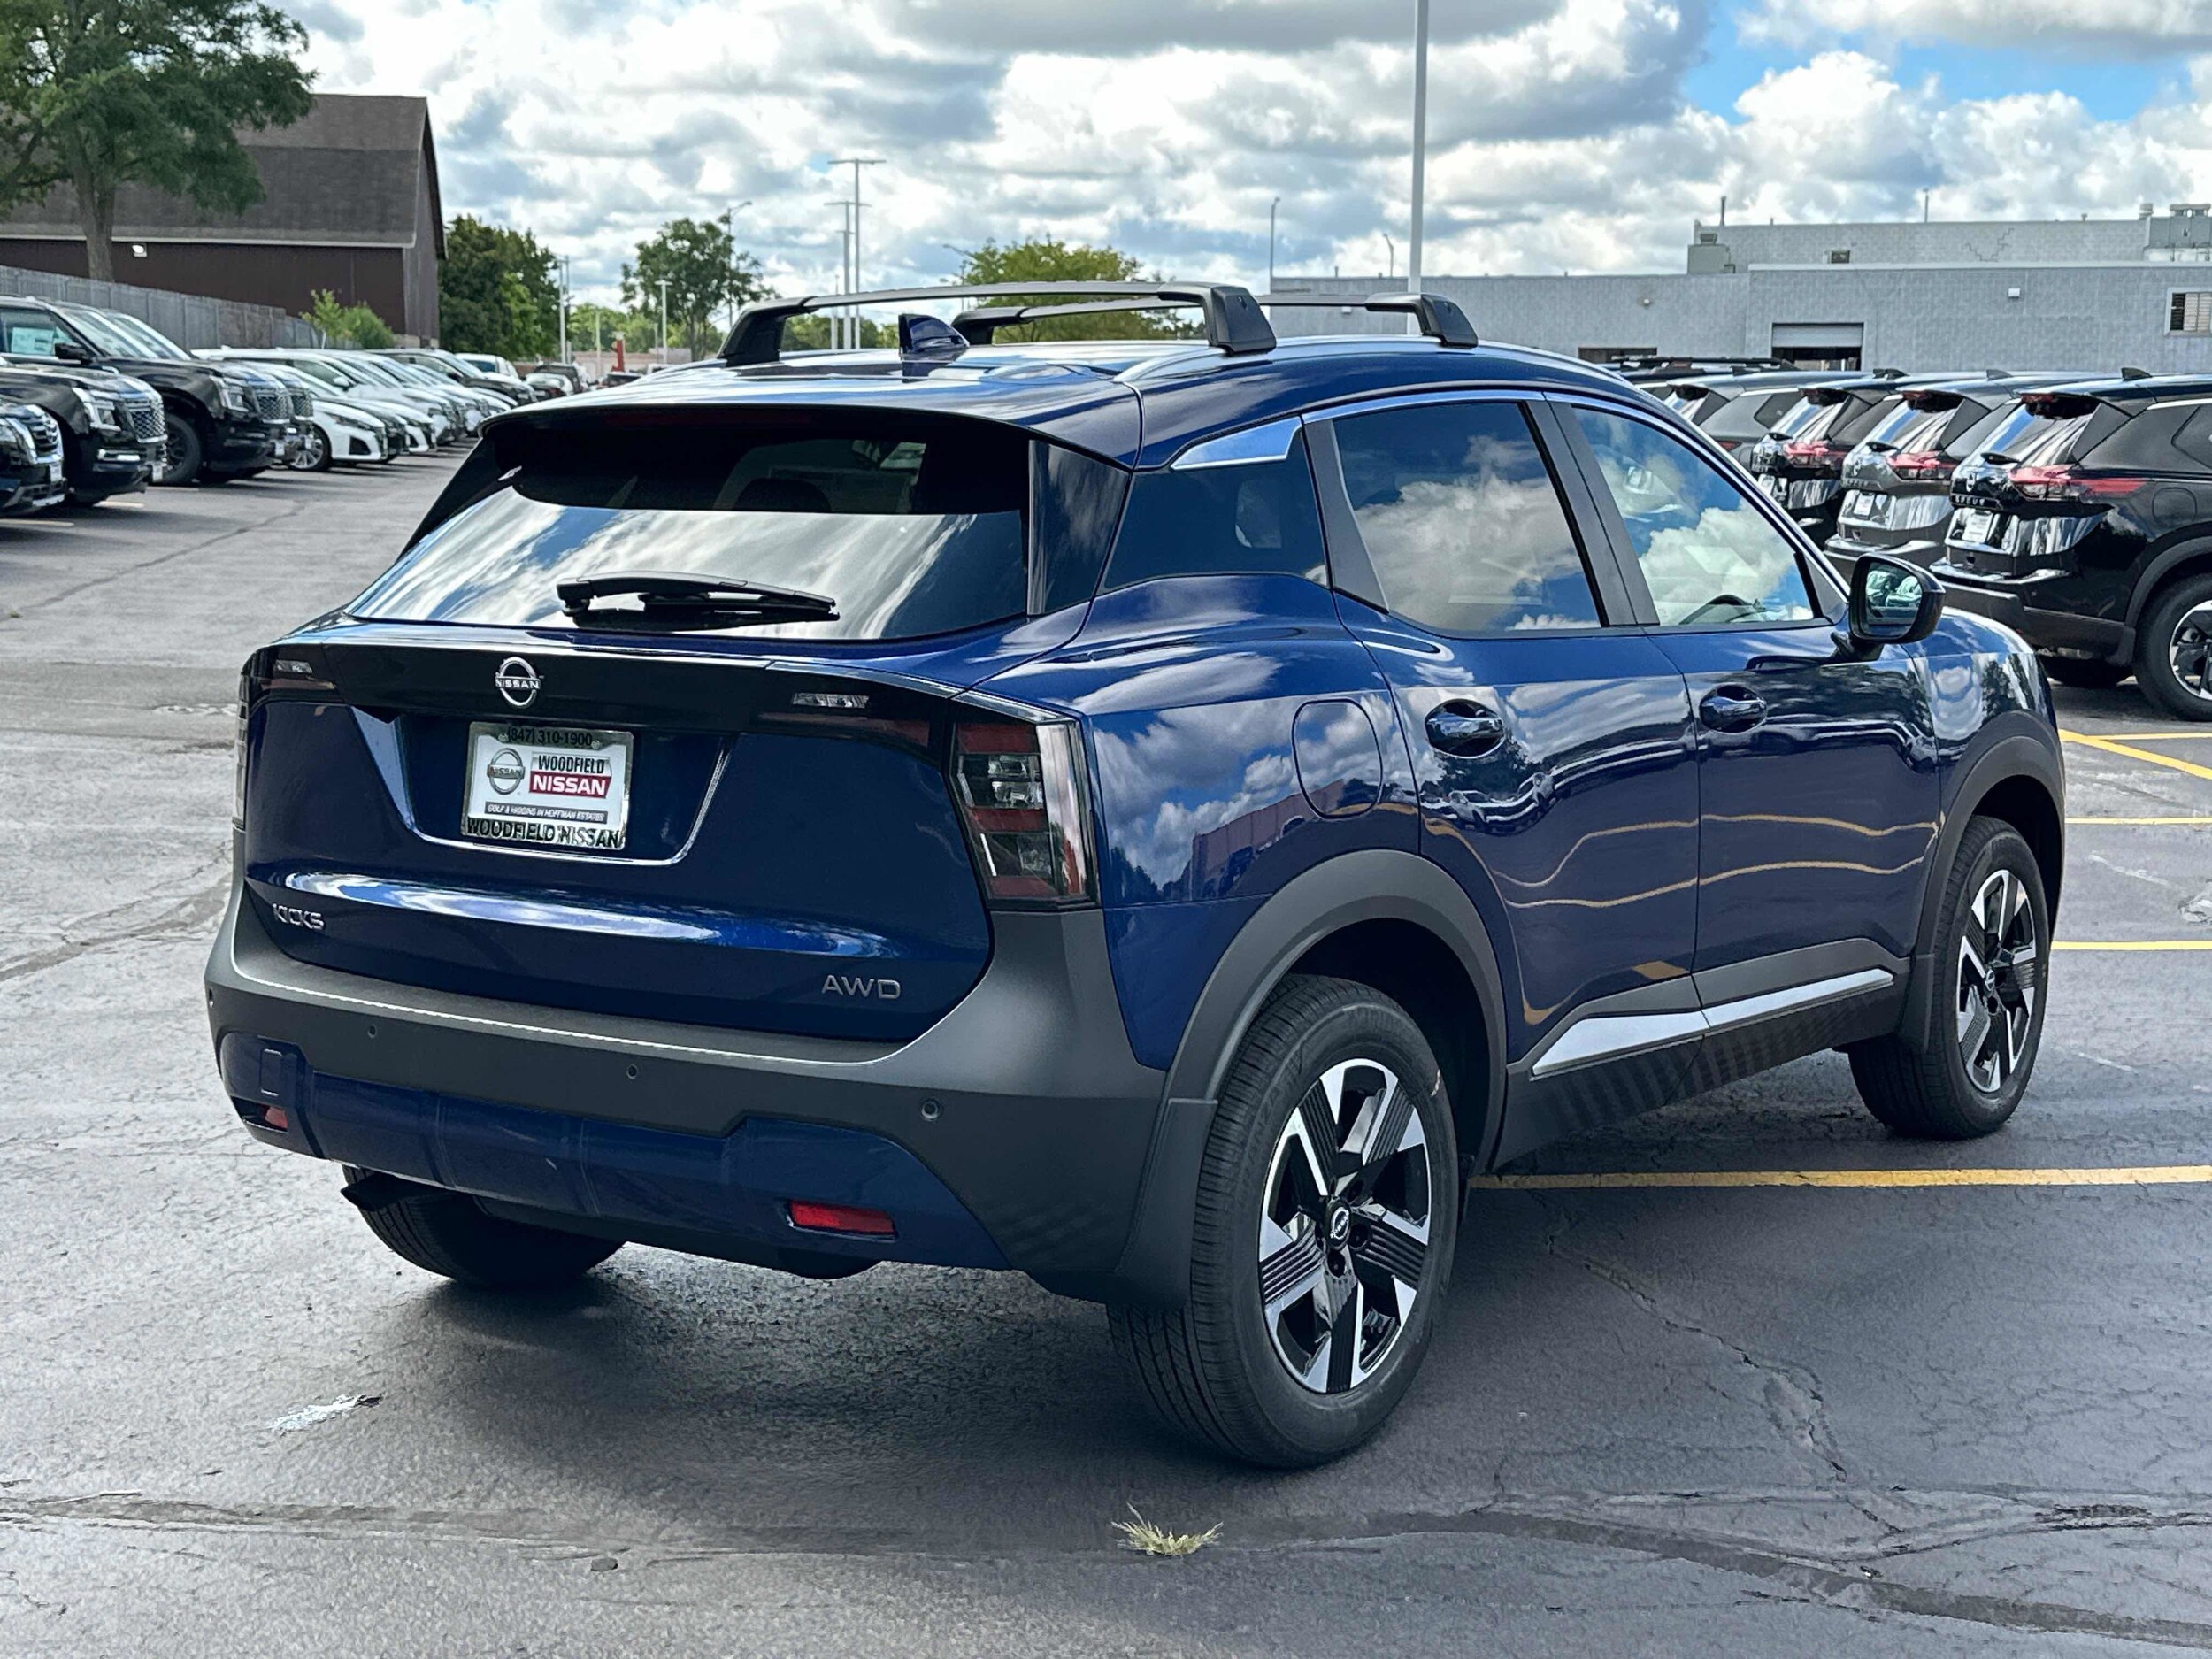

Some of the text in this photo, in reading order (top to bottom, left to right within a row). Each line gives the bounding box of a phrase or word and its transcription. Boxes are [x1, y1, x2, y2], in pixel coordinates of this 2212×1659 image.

[495, 679, 541, 690] NISSAN
[507, 726, 593, 747] (847) 310-1900
[538, 754, 605, 775] WOODFIELD
[533, 774, 607, 795] NISSAN
[467, 817, 620, 849] WOODFIELD NISSAN
[821, 974, 902, 999] AWD
